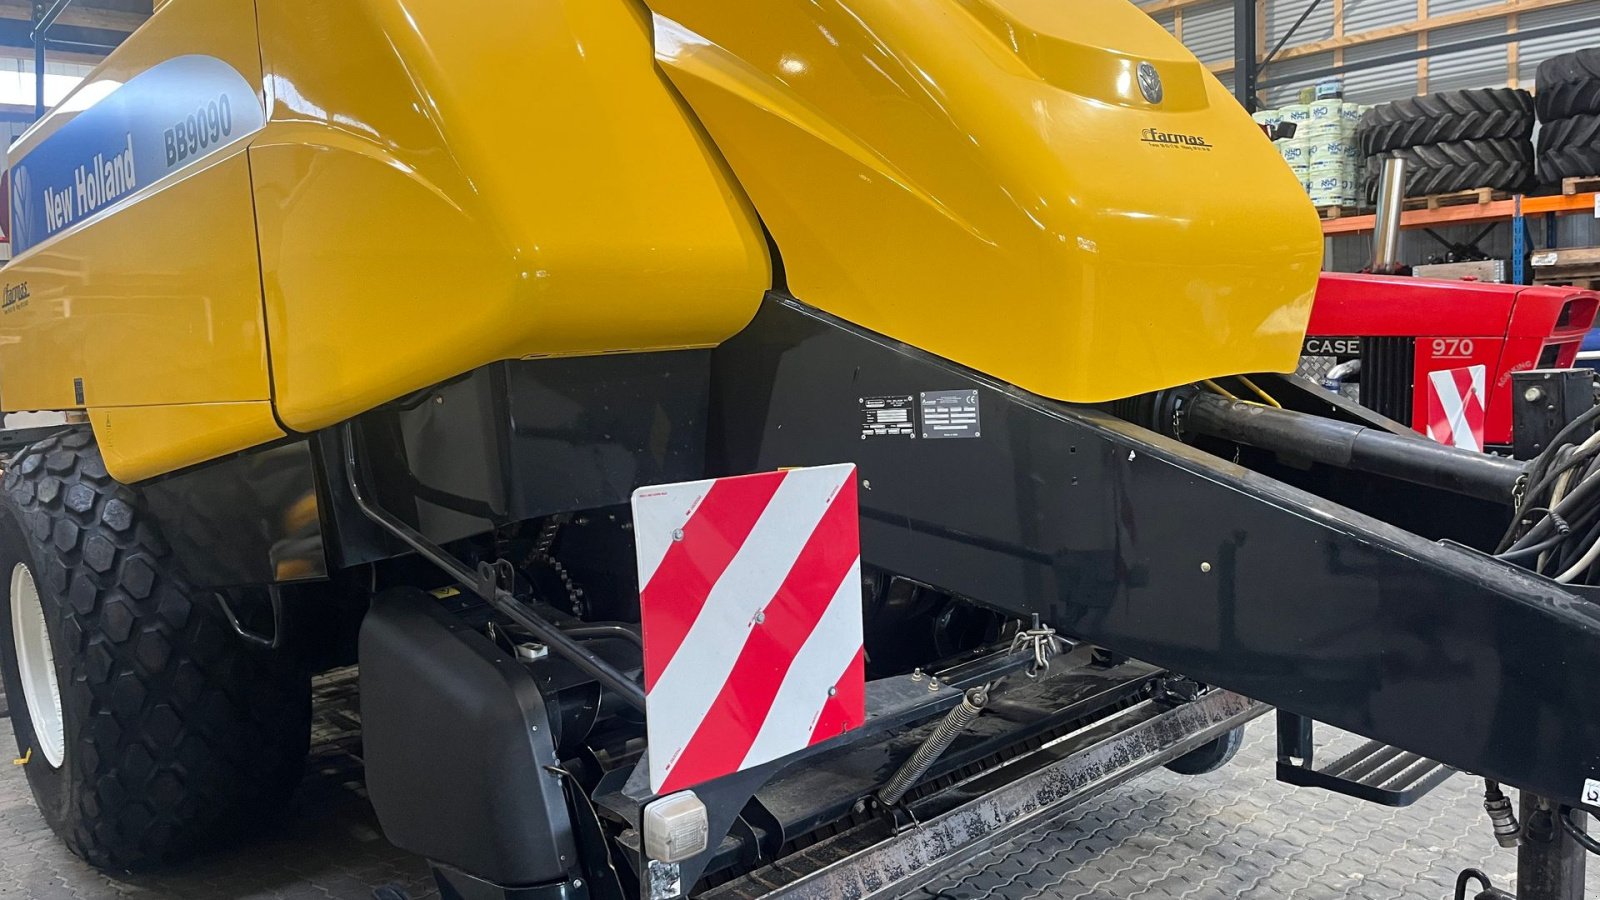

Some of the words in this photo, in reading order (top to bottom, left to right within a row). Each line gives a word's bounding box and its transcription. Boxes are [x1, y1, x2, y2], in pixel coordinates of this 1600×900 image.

[164, 94, 232, 167] BB9090
[44, 187, 73, 233] New
[75, 132, 136, 216] Holland
[1306, 340, 1360, 354] CASE
[1431, 339, 1474, 355] 970
